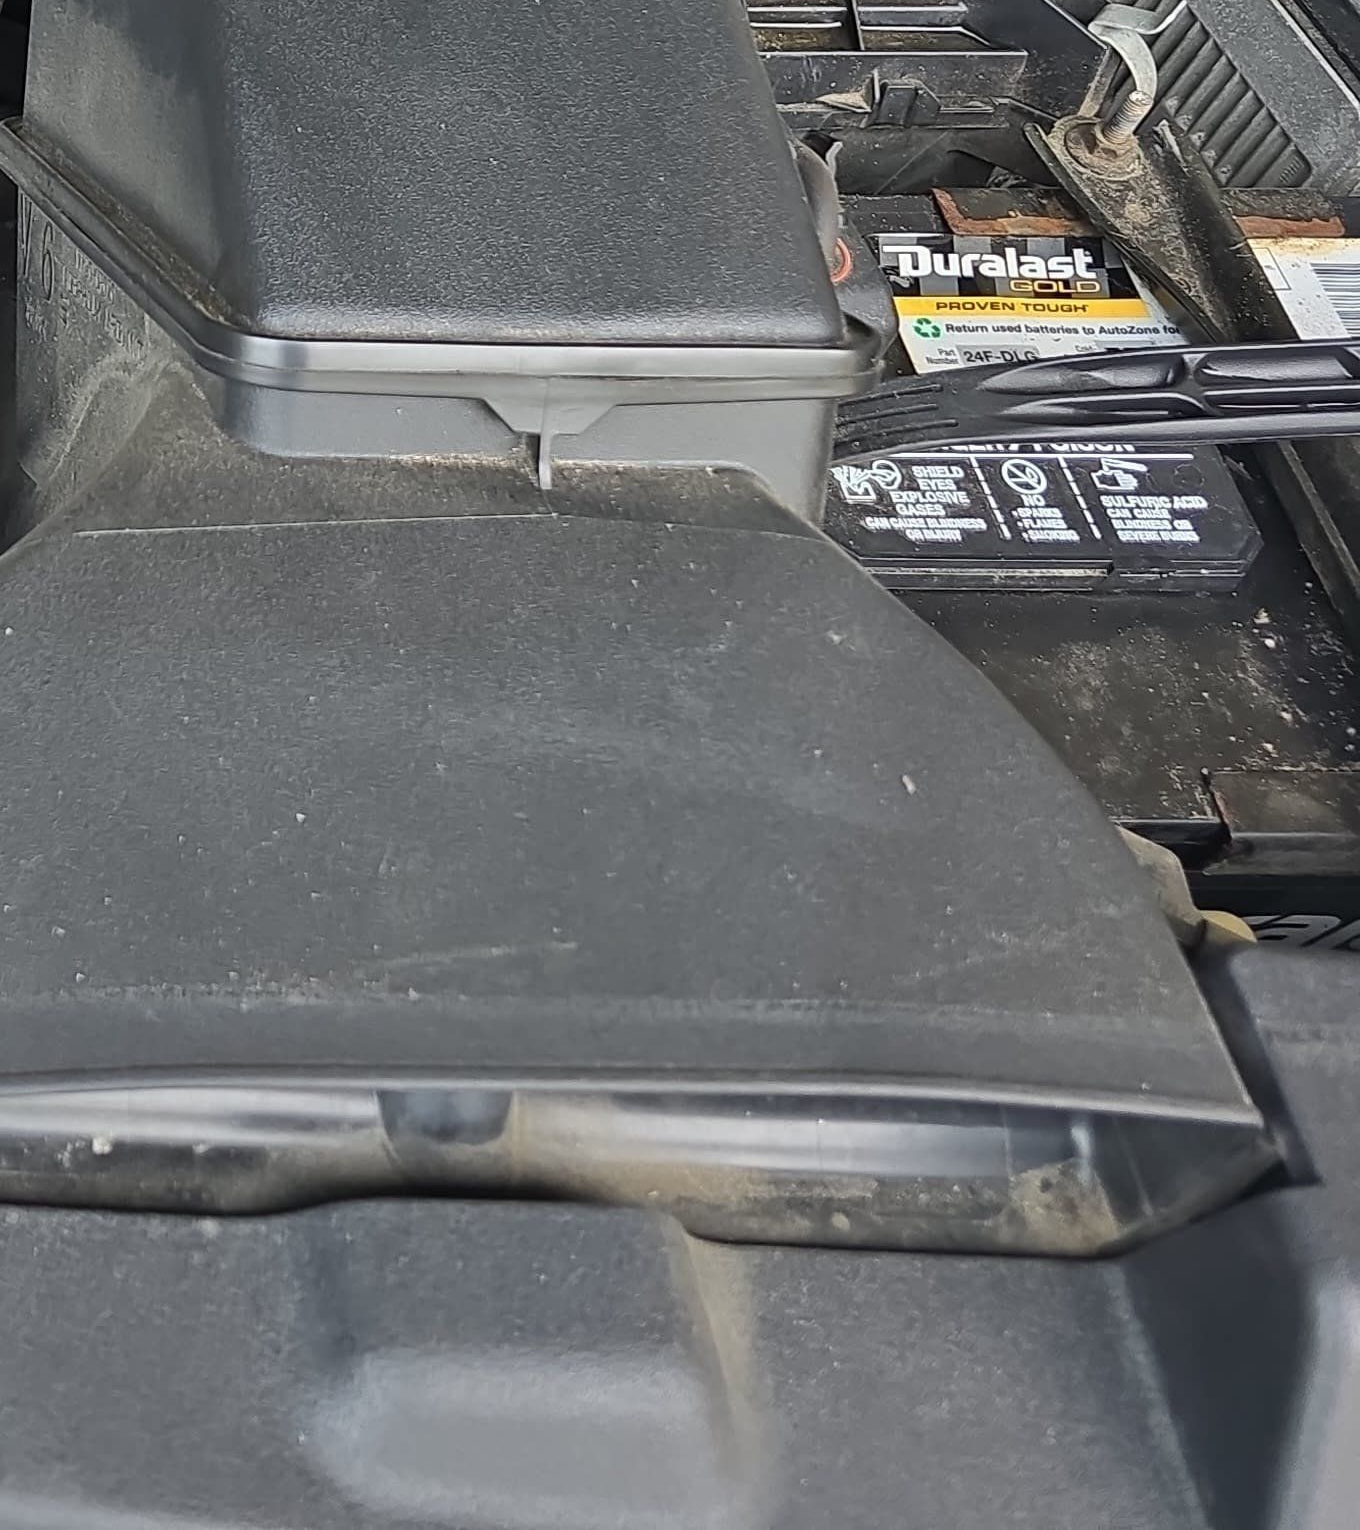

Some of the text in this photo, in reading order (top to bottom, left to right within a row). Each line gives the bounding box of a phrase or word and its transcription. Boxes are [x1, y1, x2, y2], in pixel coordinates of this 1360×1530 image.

[882, 244, 1098, 279] Duralast
[1009, 278, 1101, 294] GOLD
[935, 301, 1088, 313] PROVEN TOUGH
[945, 322, 989, 334] Return
[992, 322, 1022, 334] used
[1025, 322, 1079, 335] batteries
[1082, 324, 1096, 335] to
[1098, 324, 1160, 335] AutoZone
[963, 350, 1039, 364] 24F-DLG
[911, 465, 965, 478] SHIELD
[916, 478, 958, 491] EYES
[889, 491, 971, 506] EXPLOSIVE
[1020, 495, 1046, 506] NO
[1100, 495, 1209, 509] SULFURIC ACID
[895, 503, 946, 516] GASES
[1017, 507, 1062, 518] SPARKS
[1106, 508, 1130, 518] CAN
[1022, 518, 1068, 529] FLAMES
